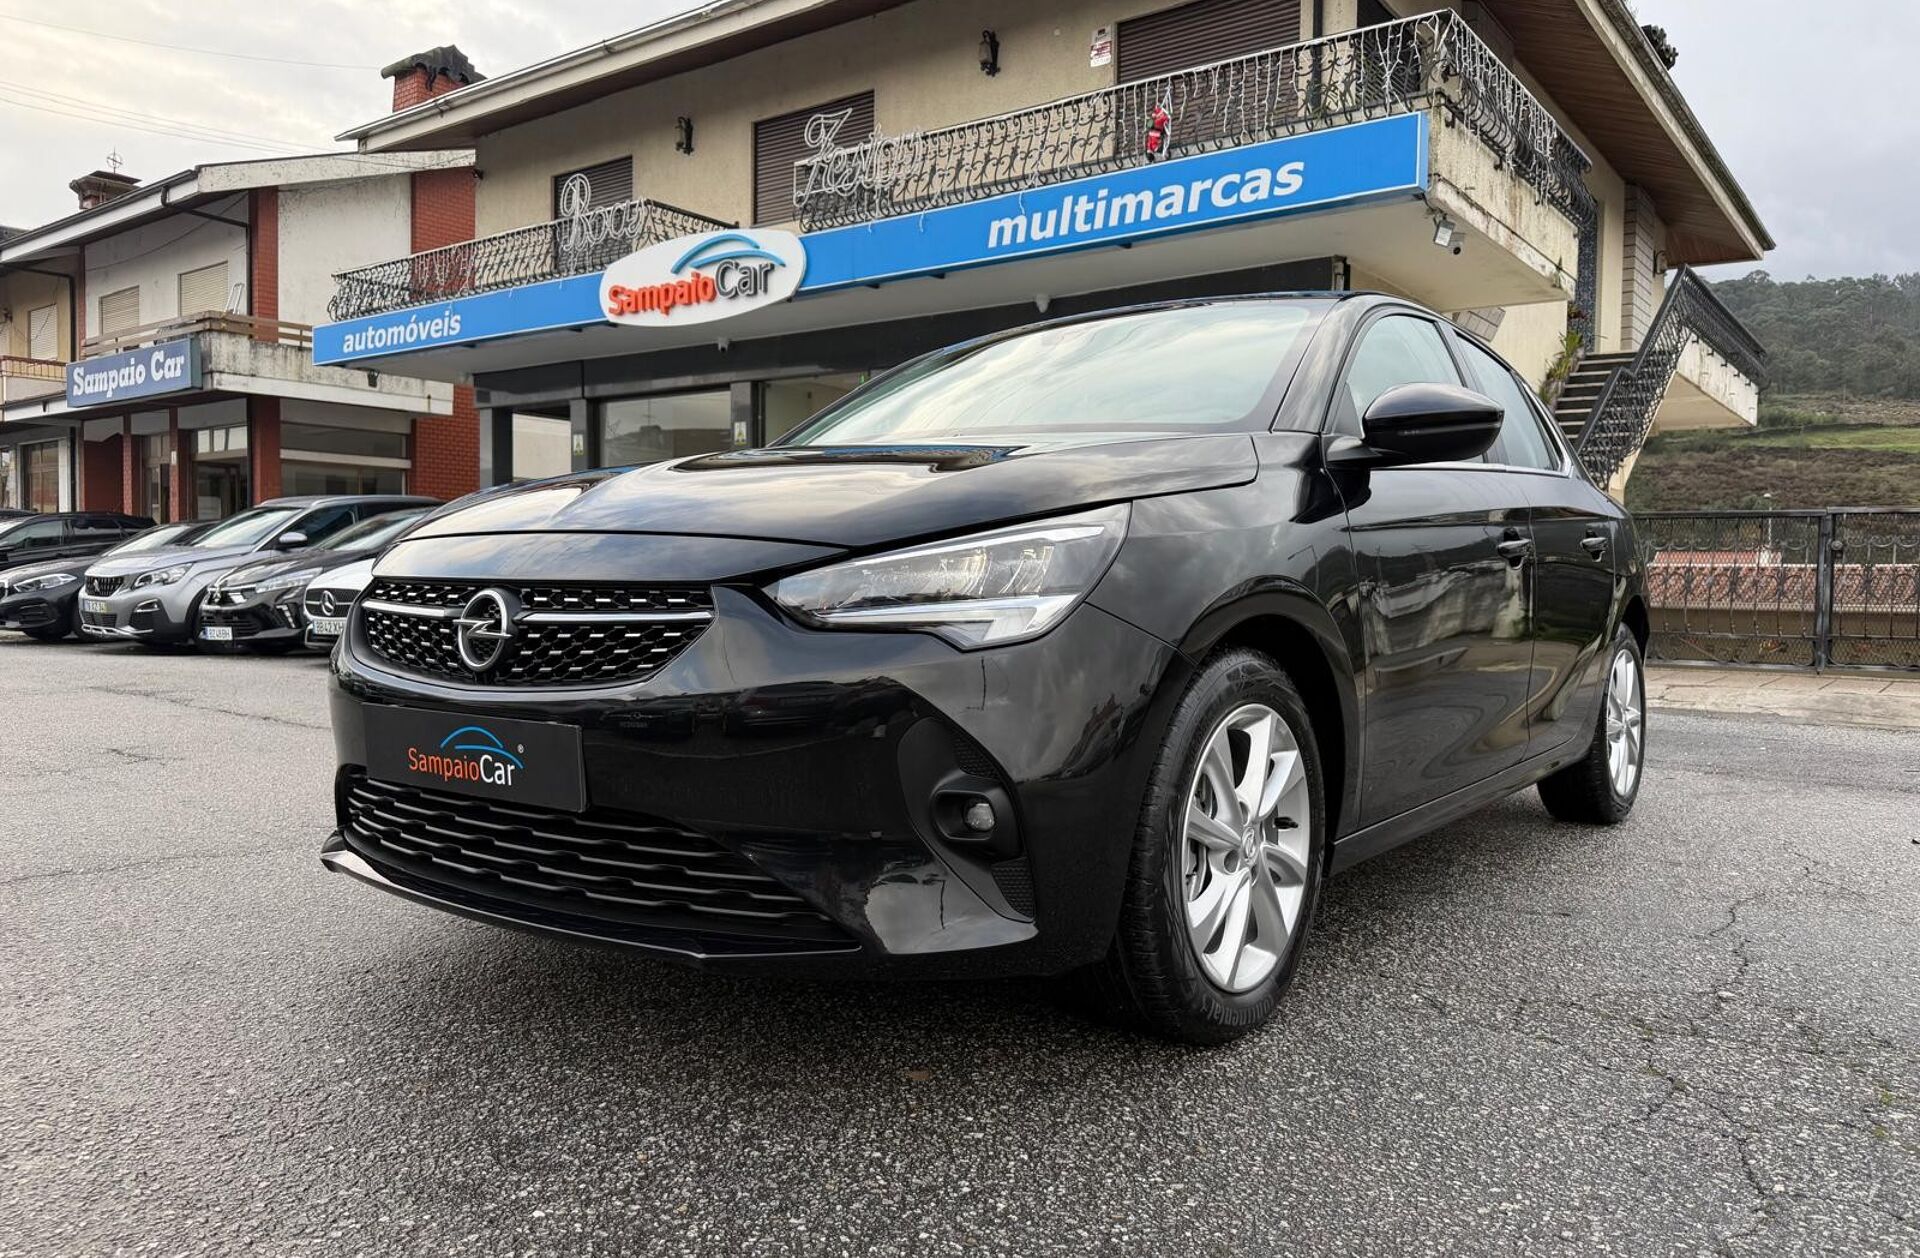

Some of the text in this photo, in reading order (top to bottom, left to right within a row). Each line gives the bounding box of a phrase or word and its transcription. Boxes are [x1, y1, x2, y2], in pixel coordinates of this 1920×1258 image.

[987, 160, 1305, 248] multimarcas
[608, 259, 775, 316] SampaioCar
[342, 310, 462, 354] automóveis
[72, 350, 185, 399] Sampaio Car
[407, 747, 516, 786] SampaioCar
